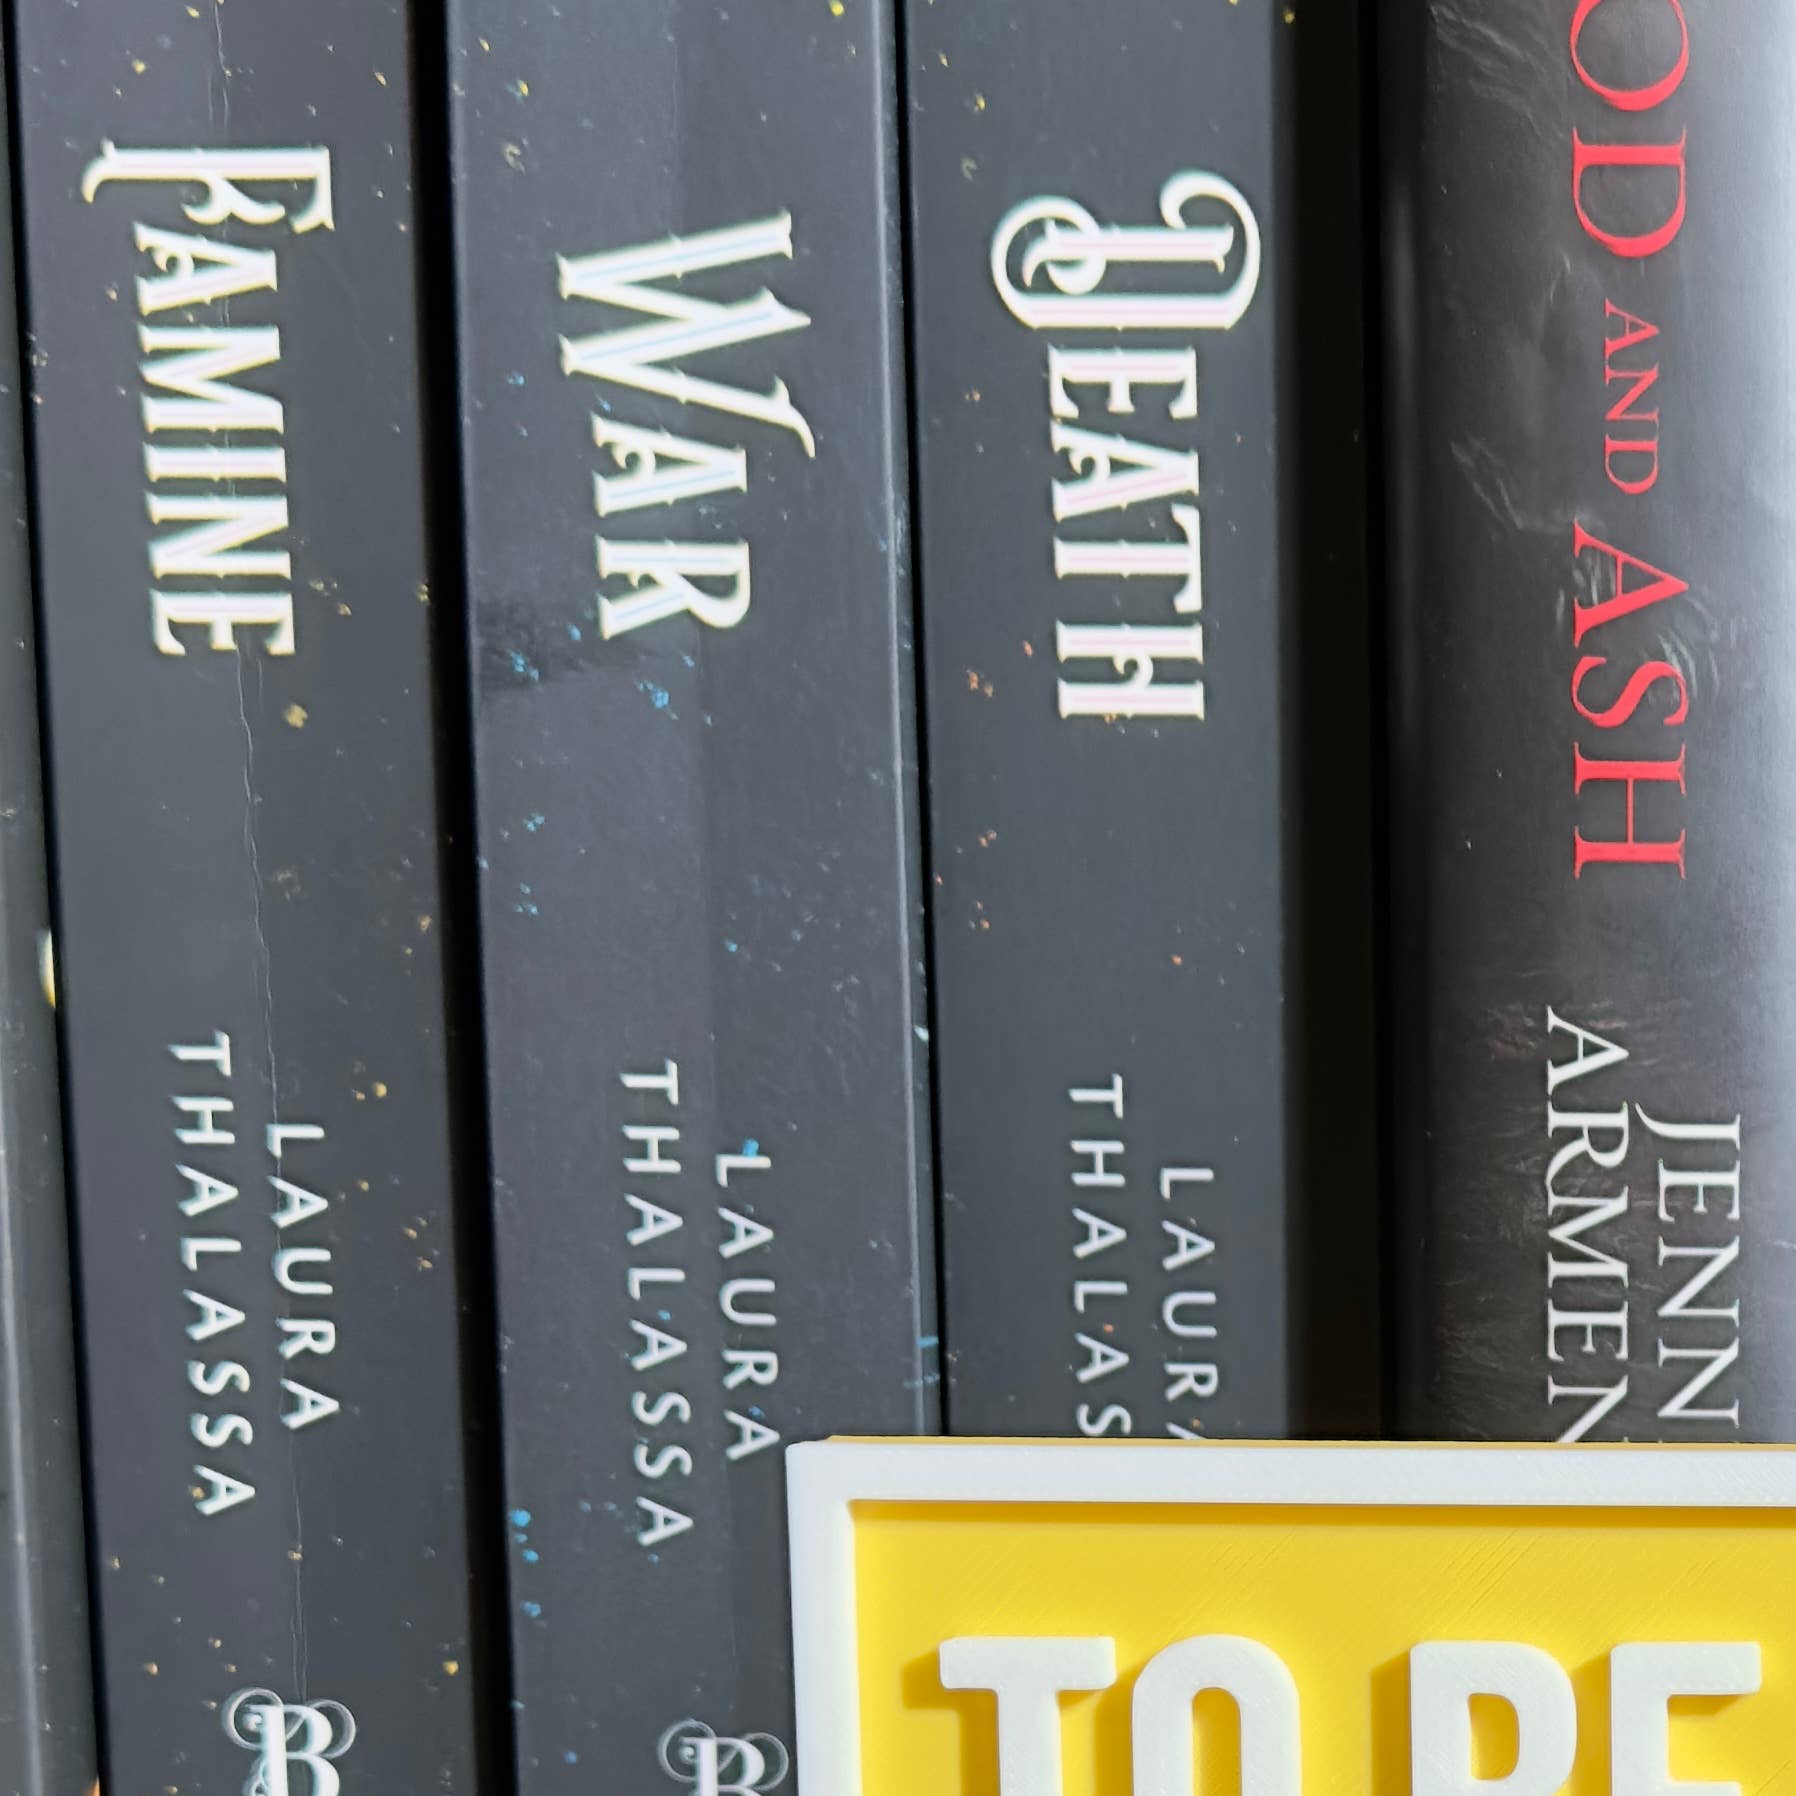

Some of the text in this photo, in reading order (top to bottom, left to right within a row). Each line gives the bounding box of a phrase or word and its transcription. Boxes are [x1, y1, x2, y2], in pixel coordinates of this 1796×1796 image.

[82, 141, 335, 656] FAMINE
[558, 209, 816, 640] WAR
[991, 170, 1261, 721] DEATH
[1604, 299, 1660, 495] AND
[1571, 520, 1690, 880] ASH
[167, 1030, 255, 1516] THALASSA
[267, 1122, 340, 1431] LAURA
[618, 1057, 694, 1547] THALASSA
[714, 1152, 780, 1461] LAURA
